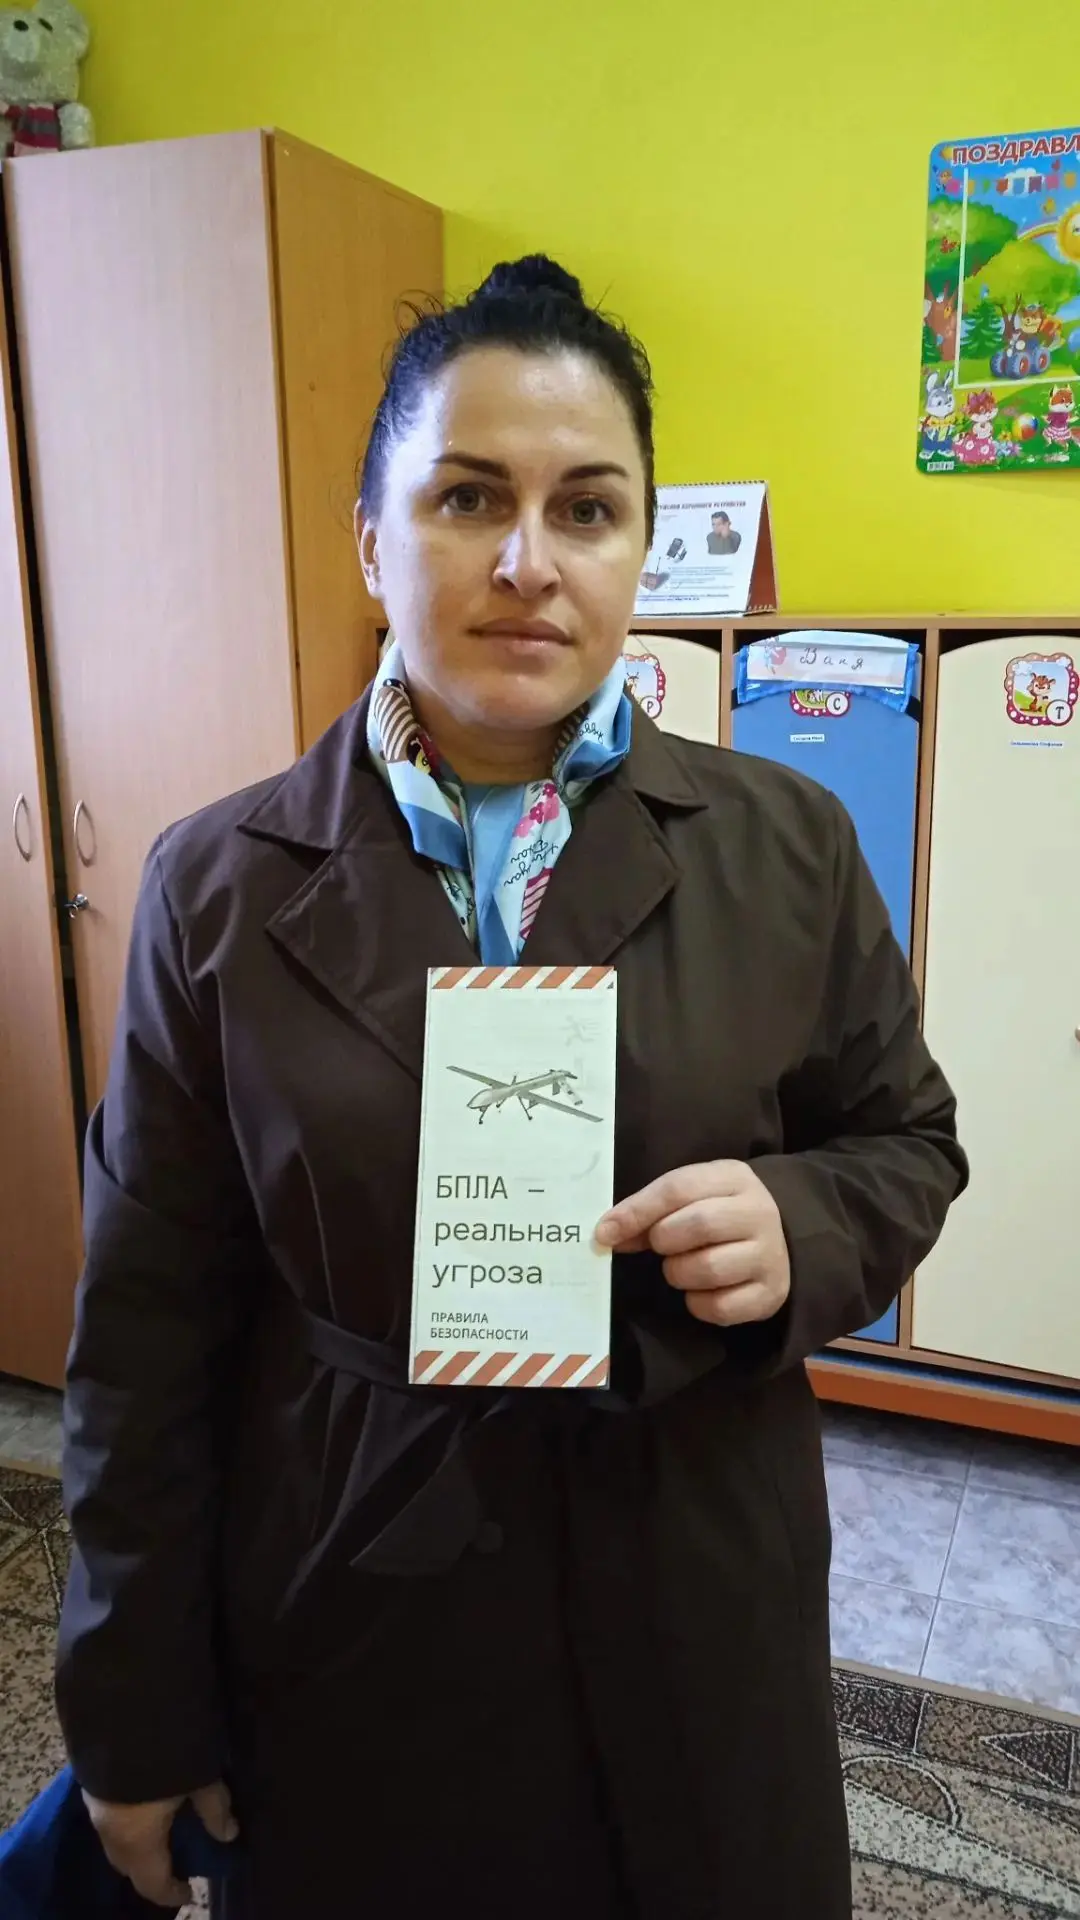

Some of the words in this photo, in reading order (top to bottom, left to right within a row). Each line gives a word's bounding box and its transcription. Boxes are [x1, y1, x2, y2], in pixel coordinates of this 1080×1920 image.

[436, 1175, 508, 1200] БПЛА
[434, 1221, 581, 1247] реальная
[432, 1263, 543, 1289] угроза
[431, 1312, 489, 1324] ПРАВИЛА
[430, 1327, 529, 1341] БЕЗОПАСНОСТИ
